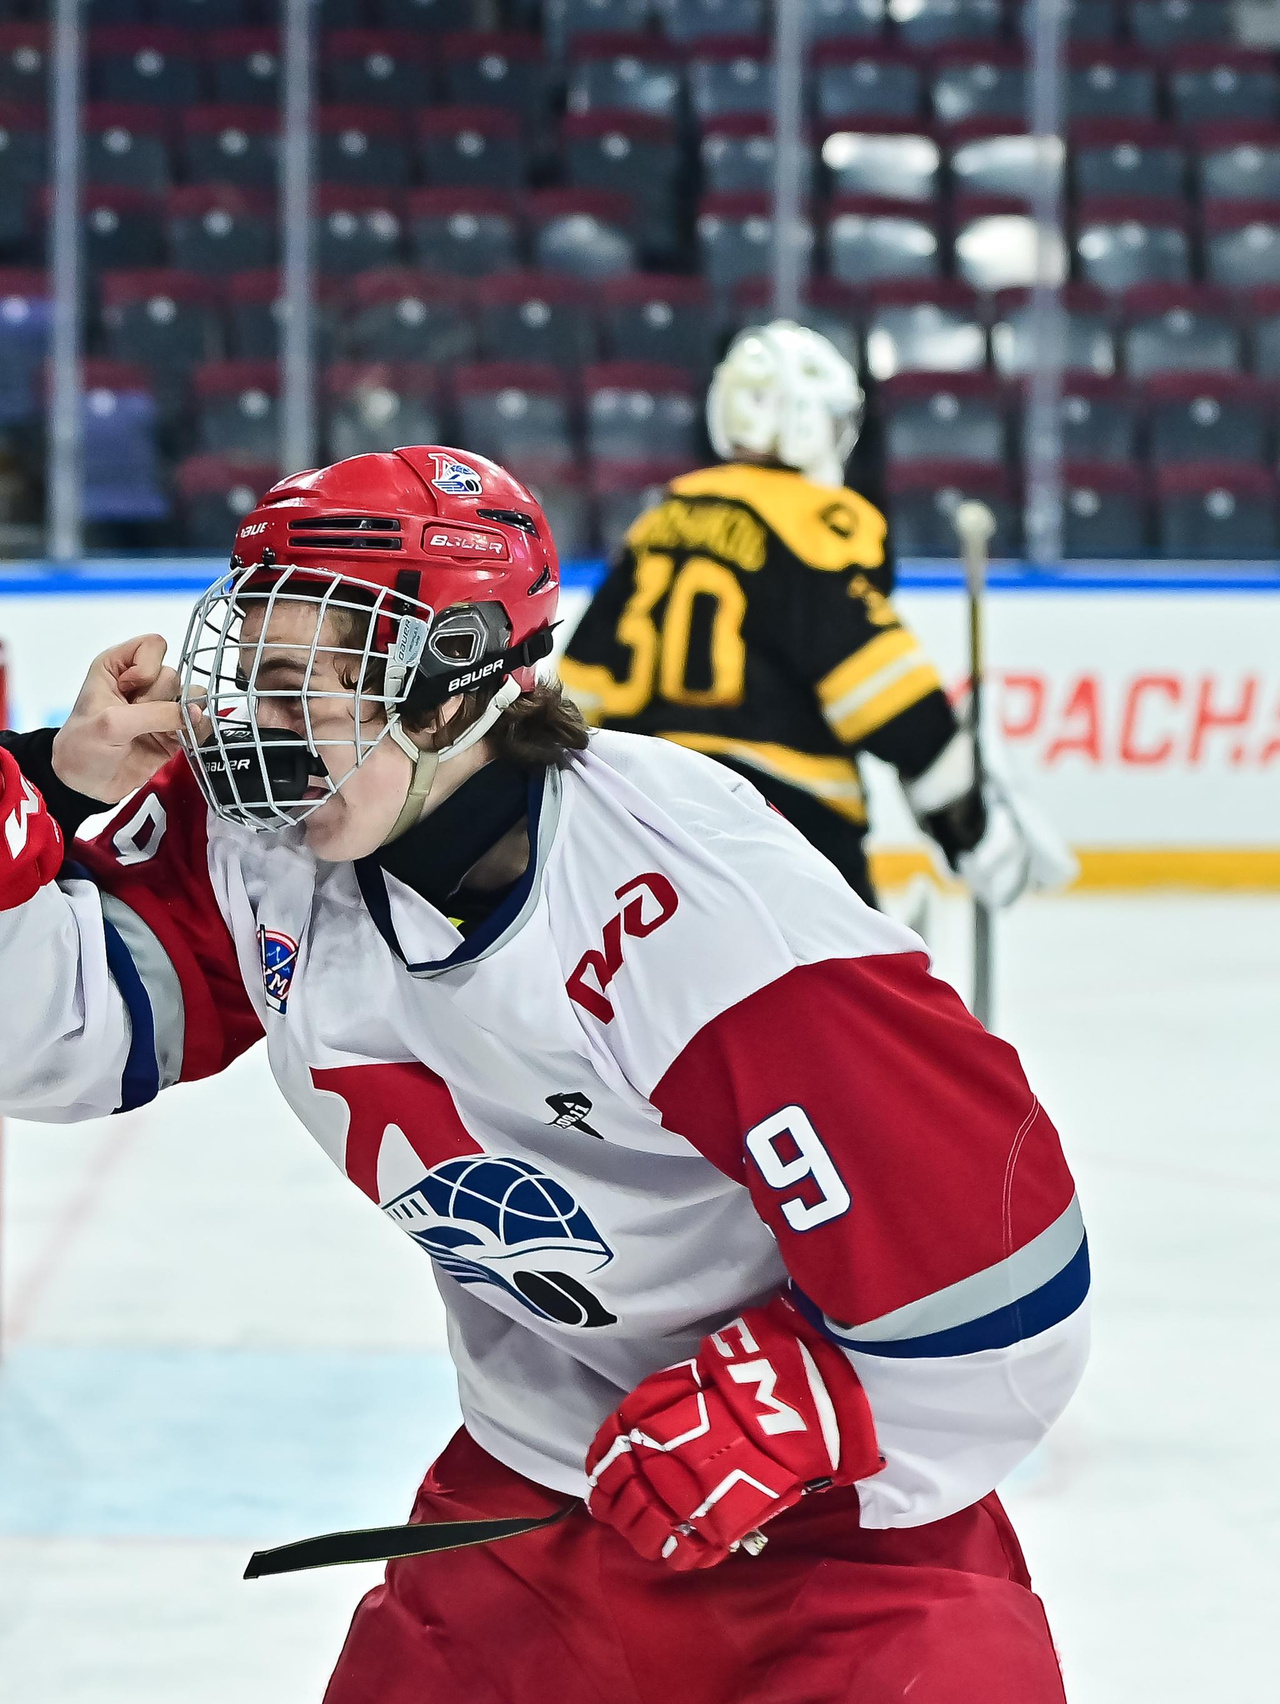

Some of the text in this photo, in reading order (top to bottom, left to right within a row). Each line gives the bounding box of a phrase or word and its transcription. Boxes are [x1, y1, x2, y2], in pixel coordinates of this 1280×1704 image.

[613, 553, 747, 717] 30
[744, 1103, 852, 1233] 9
[709, 1316, 808, 1436] CM
